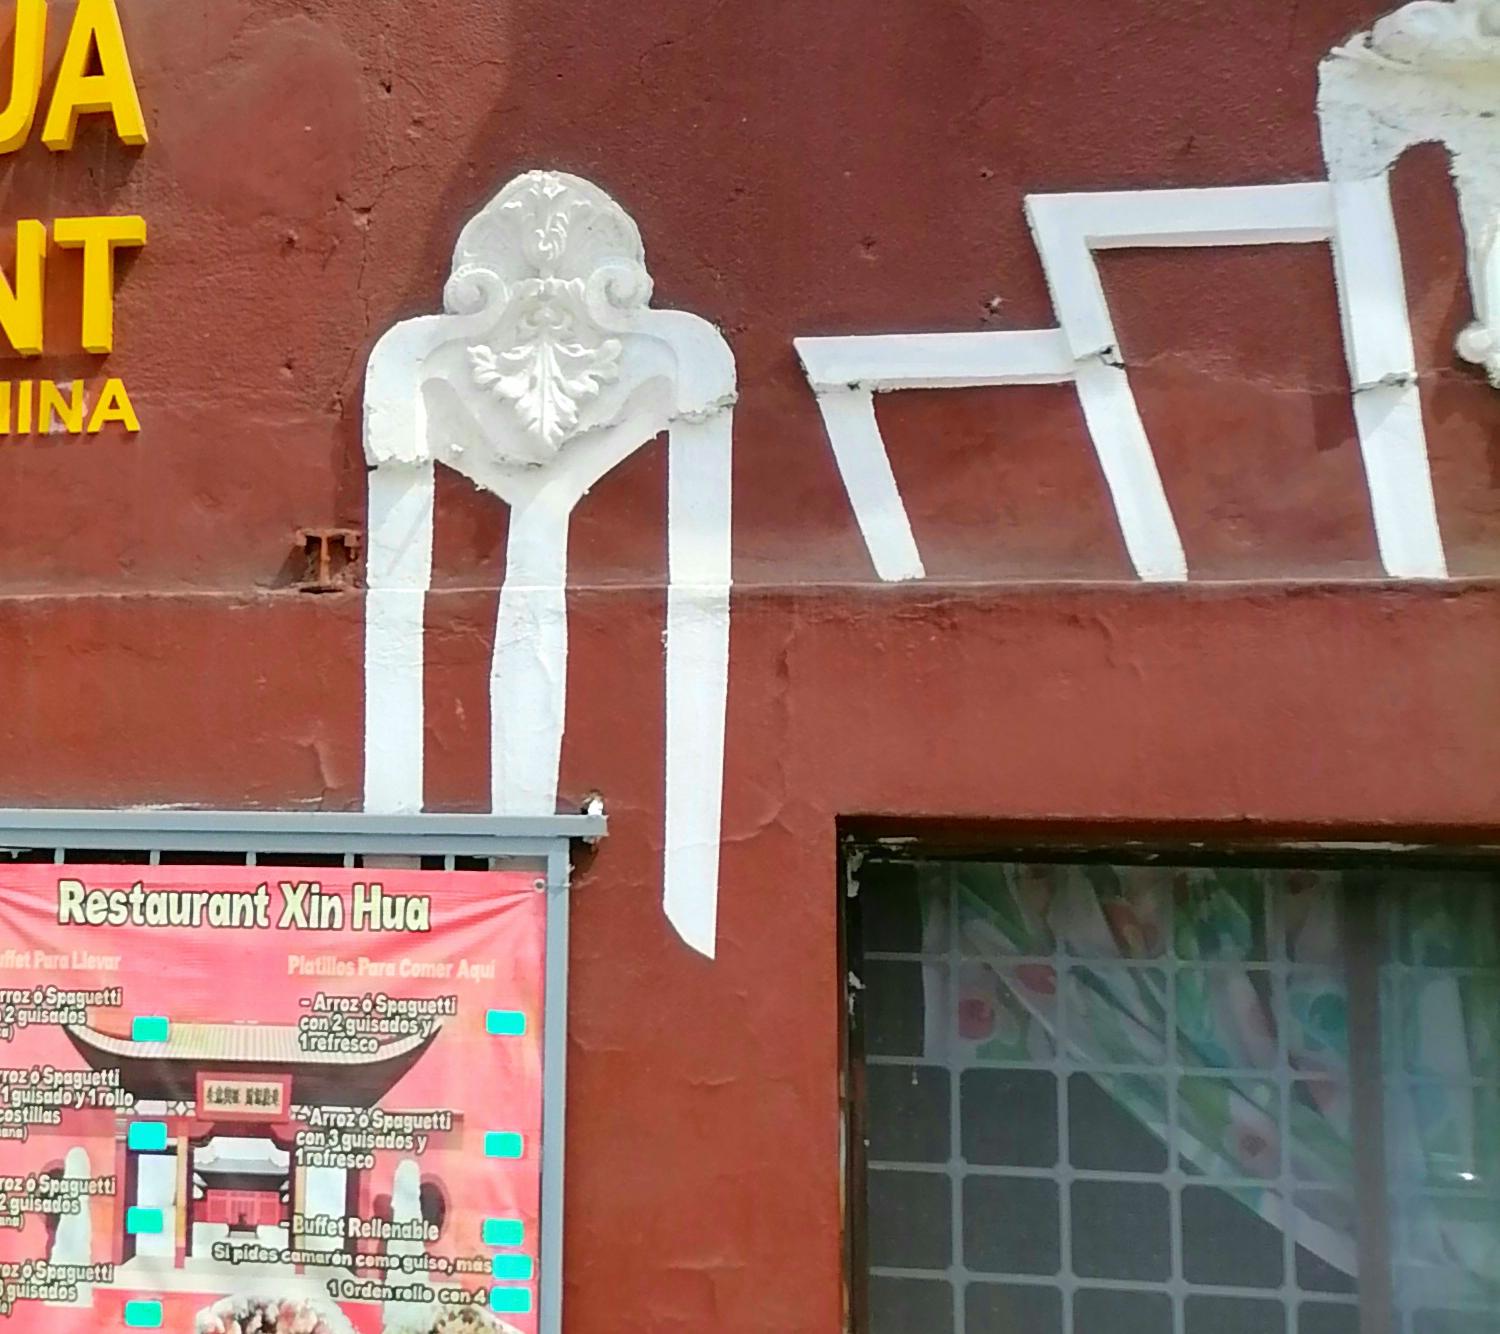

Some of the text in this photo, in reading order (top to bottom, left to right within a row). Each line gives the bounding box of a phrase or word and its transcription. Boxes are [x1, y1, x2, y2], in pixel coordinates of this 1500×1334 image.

[58, 878, 431, 931] Restaurant Xin Hua
[34, 951, 69, 969] Para
[72, 951, 122, 970] Llevar
[288, 955, 354, 976] Platillos
[358, 957, 395, 977] Para
[400, 959, 453, 978] Comer
[46, 986, 122, 1009] Spaguetti
[314, 993, 358, 1012] Arroz
[375, 995, 457, 1018] Spaguetti
[18, 1008, 86, 1026] guisados
[300, 1017, 328, 1031] con
[346, 1016, 418, 1035] guisados
[310, 1034, 378, 1052] refresco
[43, 1066, 120, 1089] Spaguetti
[12, 1088, 72, 1108] guisado
[99, 1090, 134, 1107] rollo
[309, 1107, 356, 1127] Arroz
[372, 1110, 452, 1133] Spaguetti
[296, 1132, 325, 1146] con
[342, 1130, 414, 1150] guisados
[306, 1149, 374, 1168] refresco
[39, 1174, 116, 1197] Spaguetti
[10, 1196, 80, 1215] guisados
[292, 1214, 345, 1236] Buffet
[348, 1217, 439, 1241] Rellenable
[212, 1243, 231, 1260] Si
[232, 1244, 278, 1264] pides
[355, 1253, 399, 1269] como
[402, 1252, 454, 1273] guiso,
[35, 1260, 113, 1283] Spaguetti
[7, 1282, 77, 1301] guisados
[342, 1279, 392, 1299] Orden
[395, 1283, 435, 1302] rollo
[439, 1289, 470, 1303] con
